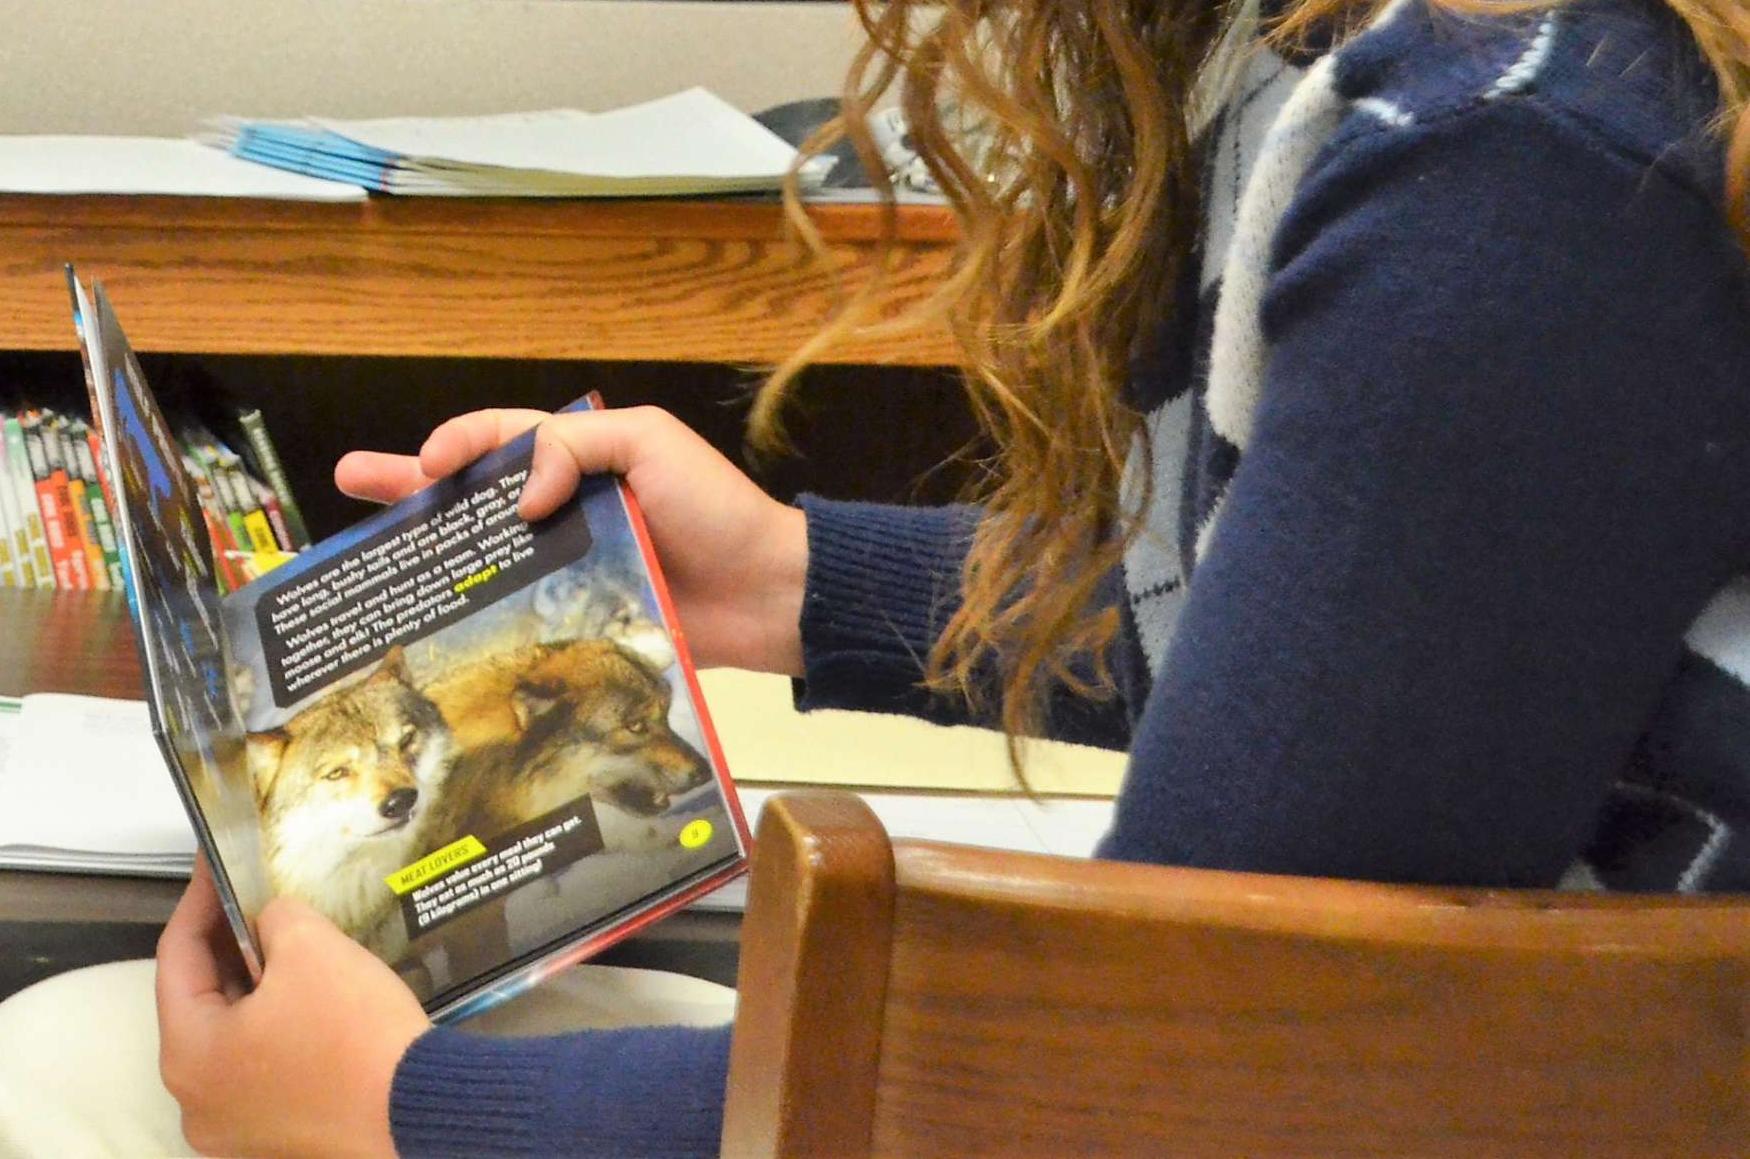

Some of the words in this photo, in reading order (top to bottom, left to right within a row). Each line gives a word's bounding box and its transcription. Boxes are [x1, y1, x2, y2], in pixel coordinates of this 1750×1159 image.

[271, 604, 300, 623] have
[301, 588, 330, 609] long,
[331, 567, 365, 591] bushy
[367, 554, 391, 572] tails
[392, 542, 415, 560] and
[417, 533, 438, 548] are
[438, 513, 475, 536] black,
[475, 497, 506, 518] gray,
[508, 488, 521, 500] or
[274, 613, 307, 635] These
[309, 592, 343, 618] social
[344, 566, 399, 599] mammals
[399, 554, 421, 571] live
[421, 548, 434, 560] in
[435, 530, 470, 555] packs
[470, 520, 484, 534] of
[485, 503, 520, 526] aroun
[276, 579, 319, 606] Wolves
[320, 567, 340, 583] are
[341, 557, 360, 572] the
[361, 536, 401, 561] largest
[402, 522, 428, 541] type
[430, 513, 443, 526] of
[444, 498, 470, 518] wild
[470, 487, 498, 506] dog.
[499, 470, 528, 489] They
[280, 635, 331, 667] together,
[332, 622, 357, 641] they
[359, 608, 382, 626] can
[382, 592, 415, 614] bring
[416, 575, 450, 596] down
[450, 559, 483, 580] large
[484, 543, 511, 564] prey
[512, 533, 534, 549] like
[285, 622, 330, 648] Wolves
[330, 602, 362, 627] travel
[364, 588, 388, 609] and
[388, 576, 415, 596] hunt
[416, 572, 432, 583] as
[433, 565, 442, 575] a
[443, 549, 477, 569] team.
[477, 521, 528, 551] Working
[284, 654, 323, 680] moose
[324, 640, 348, 659] and
[372, 617, 394, 634] The
[395, 588, 453, 622] predators
[453, 564, 498, 593] adapt
[498, 558, 512, 571] to
[512, 546, 535, 563] live
[287, 659, 340, 693] wherever
[340, 643, 372, 665] there
[373, 637, 384, 649] is
[384, 617, 421, 643] plenty
[423, 610, 436, 623] of
[437, 593, 470, 614] food.
[400, 864, 427, 885] MEAT
[412, 880, 445, 901] Wolves
[446, 867, 471, 886] value
[471, 854, 499, 874] every
[499, 841, 522, 860] meal
[522, 832, 545, 850] they
[545, 824, 563, 839] can
[563, 816, 582, 832] get.
[415, 897, 437, 914] They
[438, 887, 454, 902] eat
[467, 869, 494, 888] much
[505, 855, 521, 870] 20
[521, 842, 556, 865] pounds
[479, 884, 490, 896] in
[490, 876, 509, 891] one
